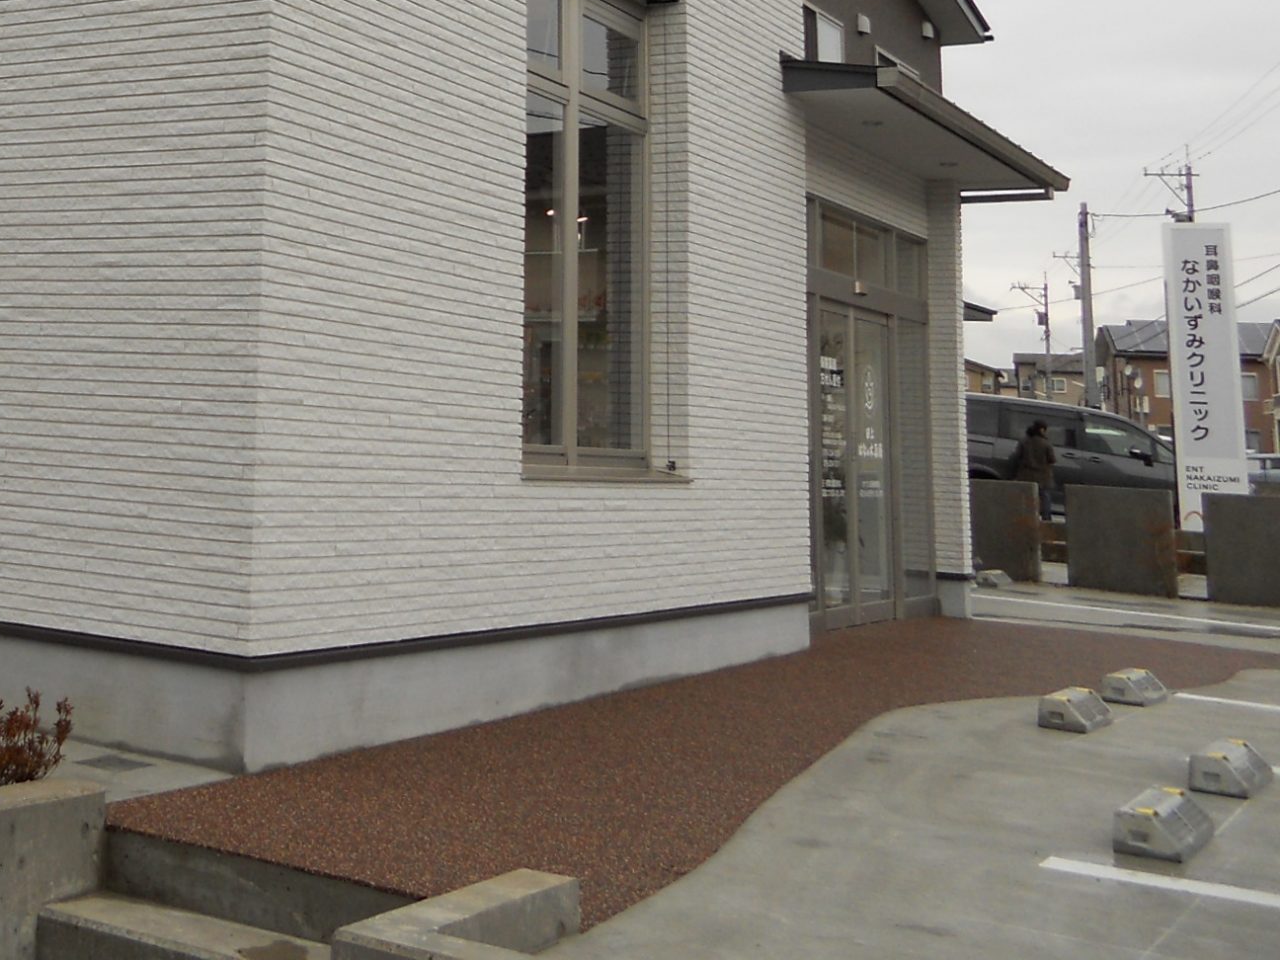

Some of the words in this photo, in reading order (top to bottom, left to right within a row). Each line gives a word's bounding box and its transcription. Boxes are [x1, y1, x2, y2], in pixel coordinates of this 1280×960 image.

[1204, 244, 1222, 315] 耳鼻咽喉科
[1181, 259, 1209, 441] なかいずみクリニック
[1186, 474, 1240, 483] NAKAIZUMI
[1186, 482, 1219, 491] CLINIC
